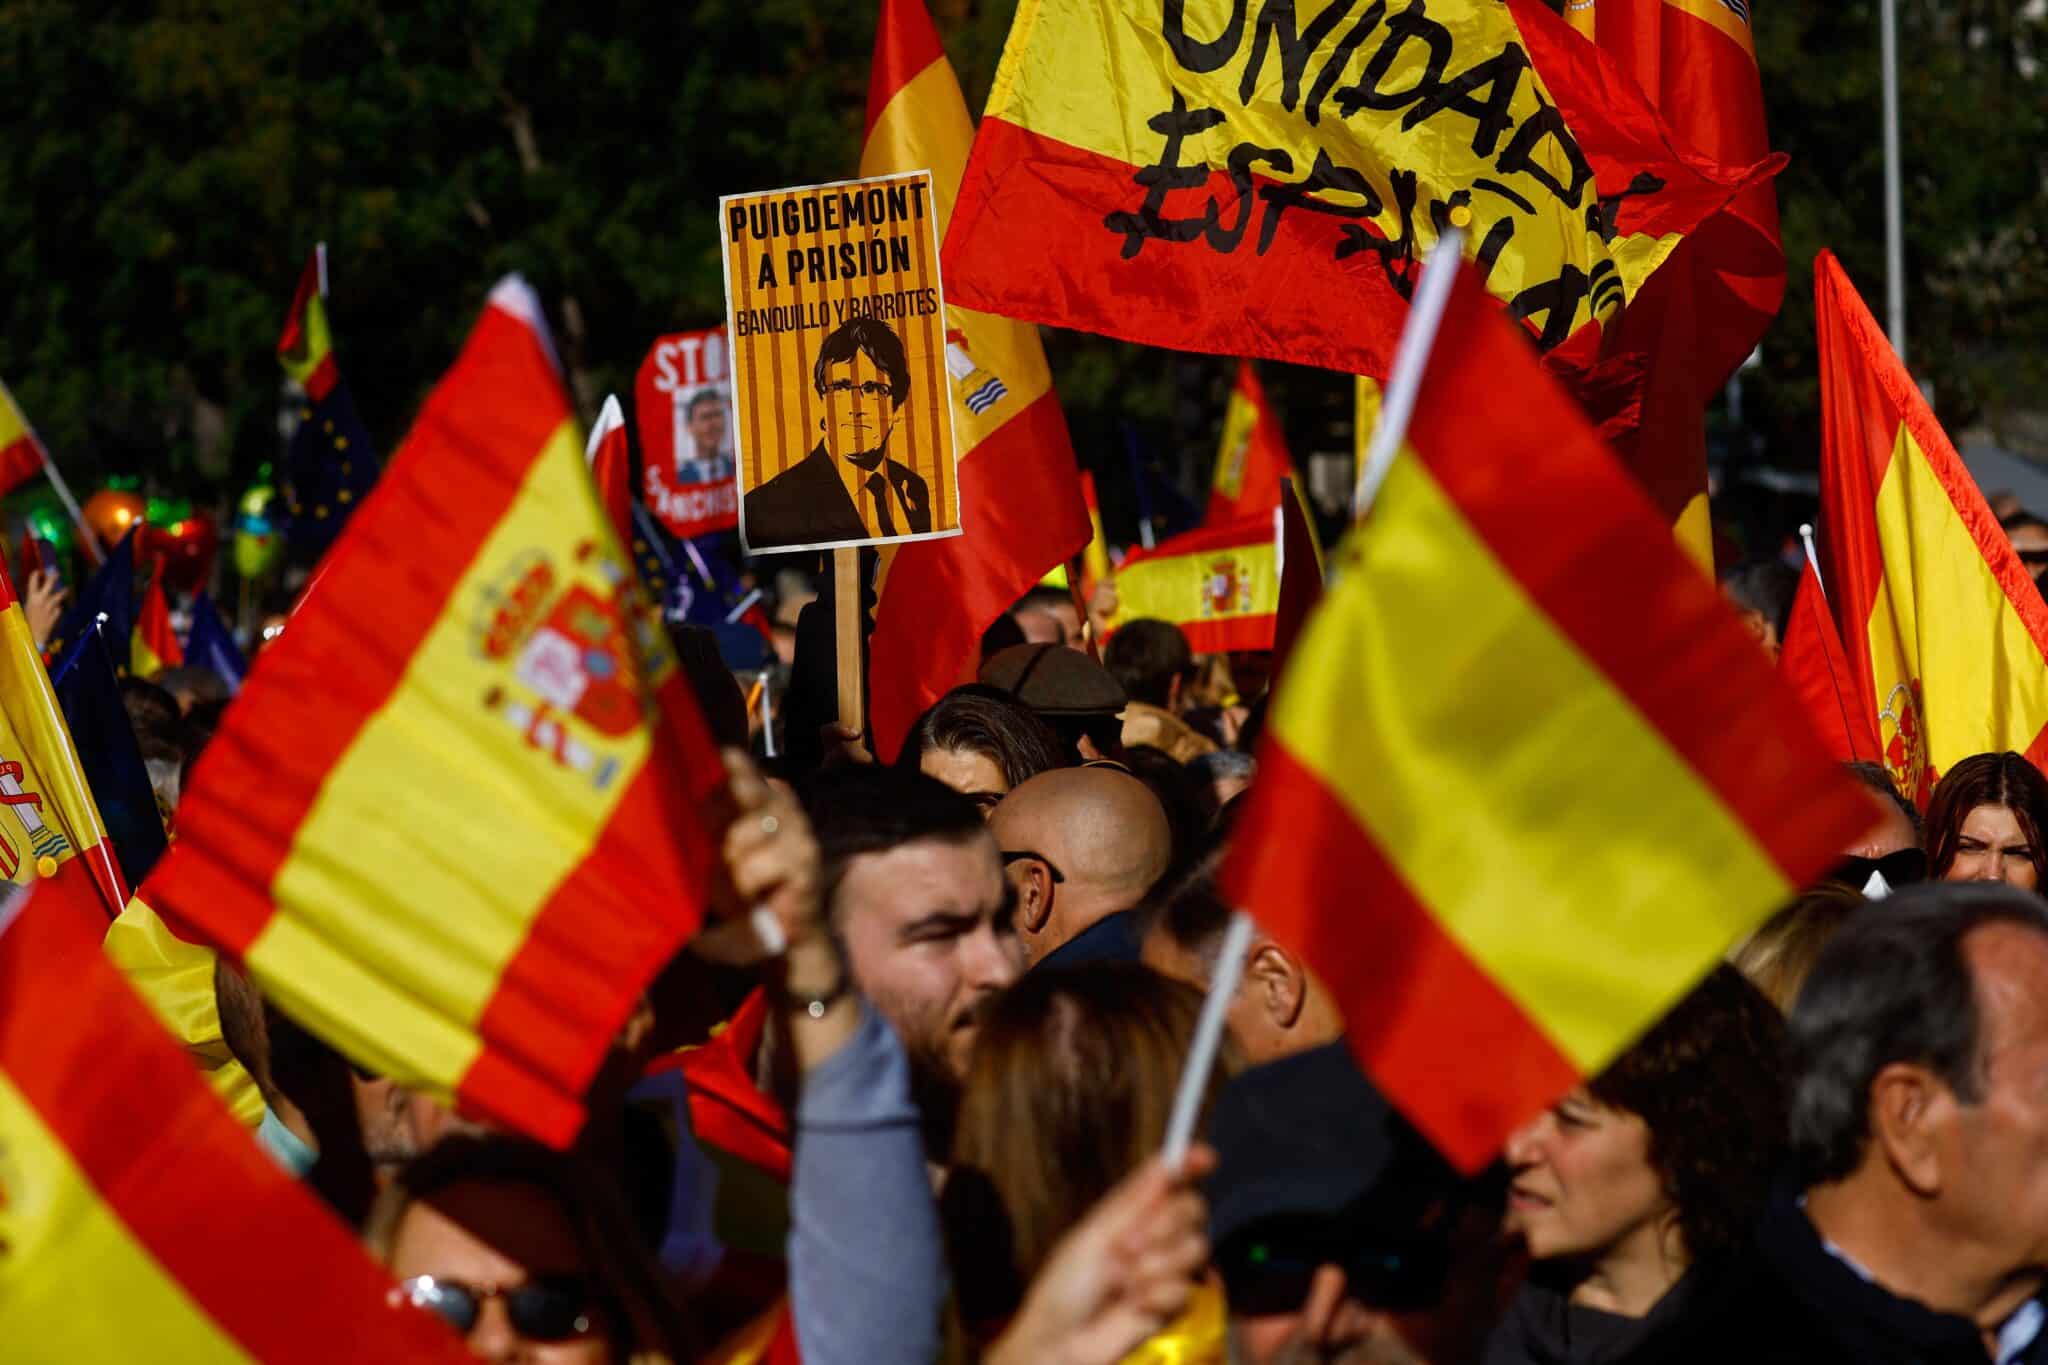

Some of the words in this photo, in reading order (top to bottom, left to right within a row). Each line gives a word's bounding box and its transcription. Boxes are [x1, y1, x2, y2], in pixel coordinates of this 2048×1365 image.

[1163, 0, 1597, 210] UNIDAD
[729, 182, 927, 243] PUIGDEMONT
[757, 253, 778, 289] A
[787, 229, 910, 286] PRISIÓN
[737, 301, 830, 336] BANQUILLO
[833, 299, 846, 325] Y
[851, 288, 937, 321] BARROTES
[653, 332, 730, 391] STO
